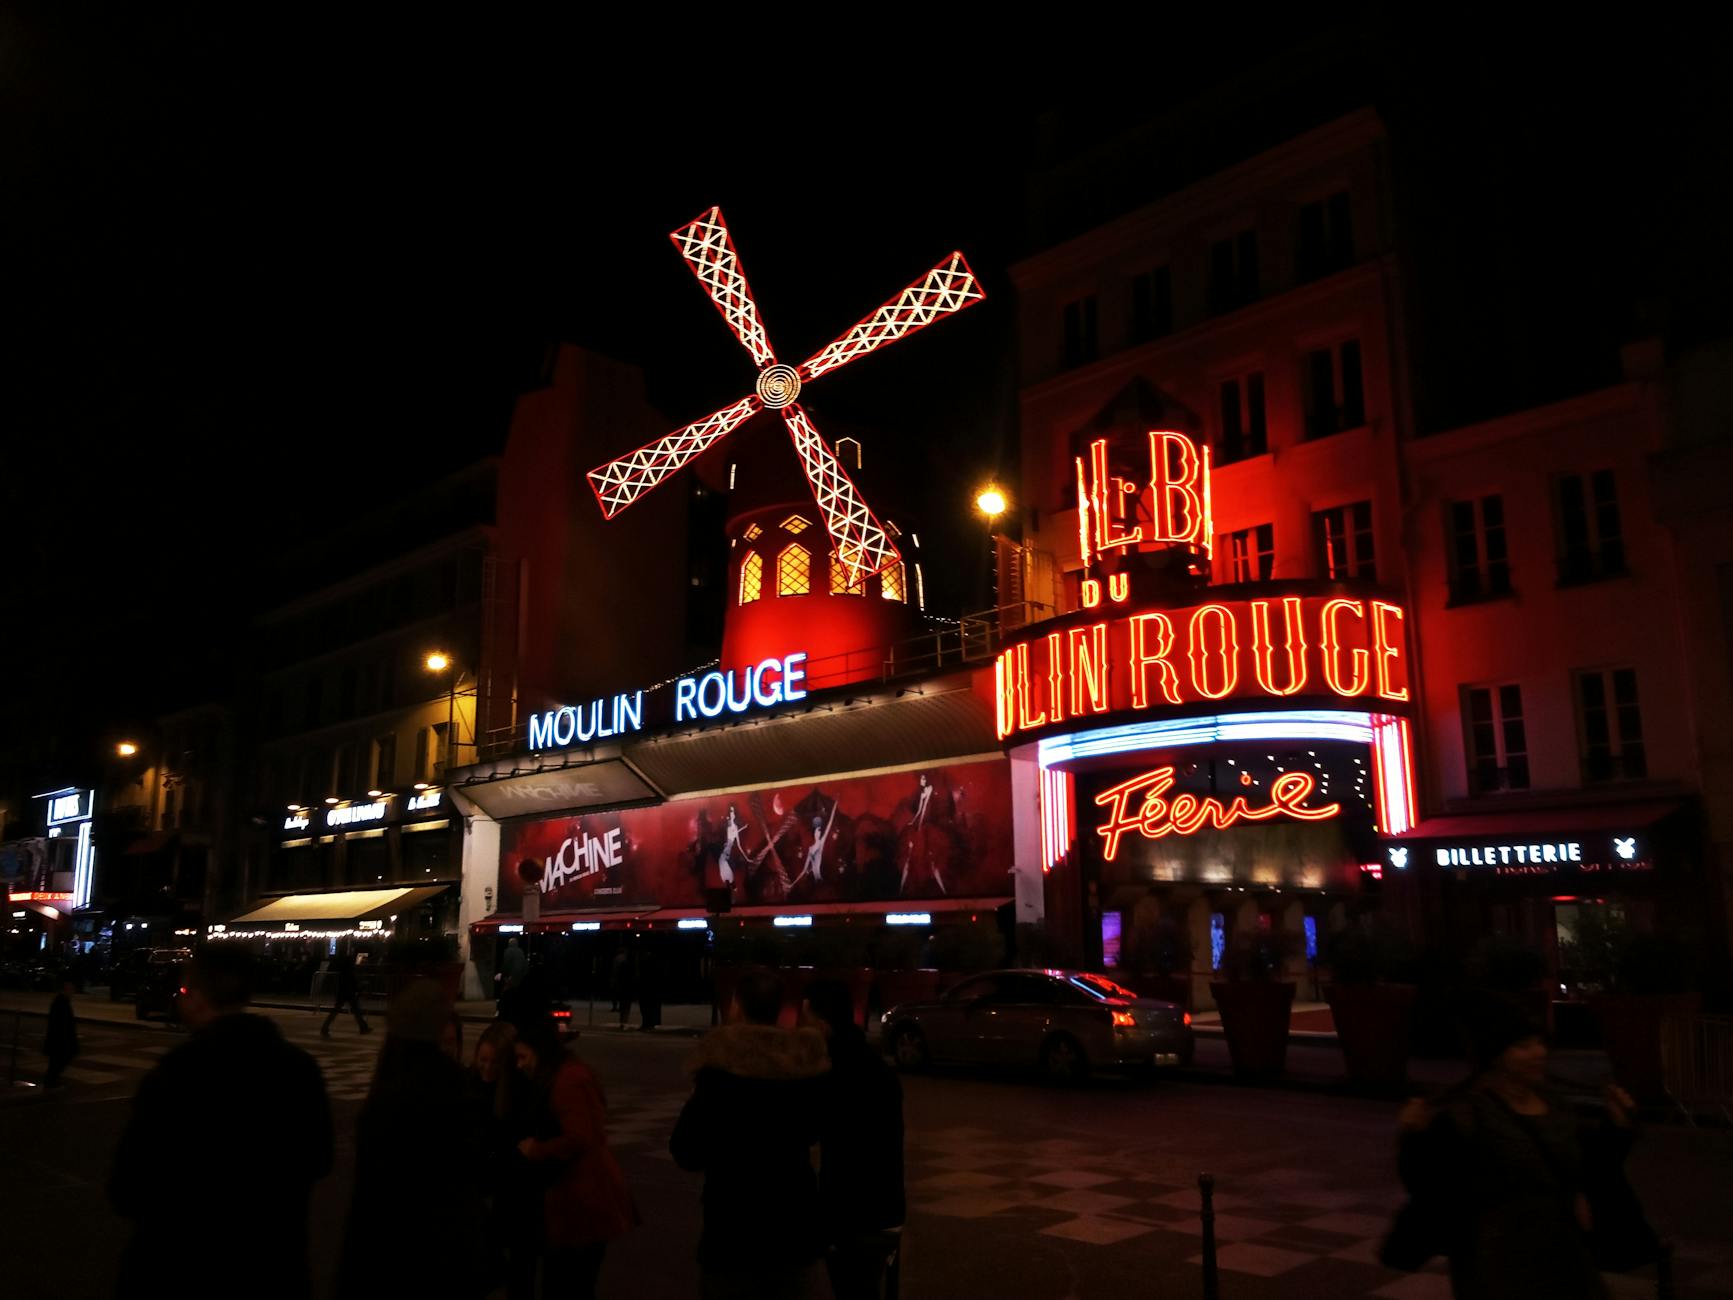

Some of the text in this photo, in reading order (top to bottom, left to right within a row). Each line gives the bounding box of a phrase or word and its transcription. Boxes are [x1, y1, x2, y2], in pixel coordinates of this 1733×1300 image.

[1082, 573, 1128, 607] DU
[1130, 598, 1409, 709] ROUGE
[529, 652, 807, 750] MOULIN ROUGE
[1096, 767, 1340, 861] Féerie
[1436, 842, 1582, 867] BILLETTERIE
